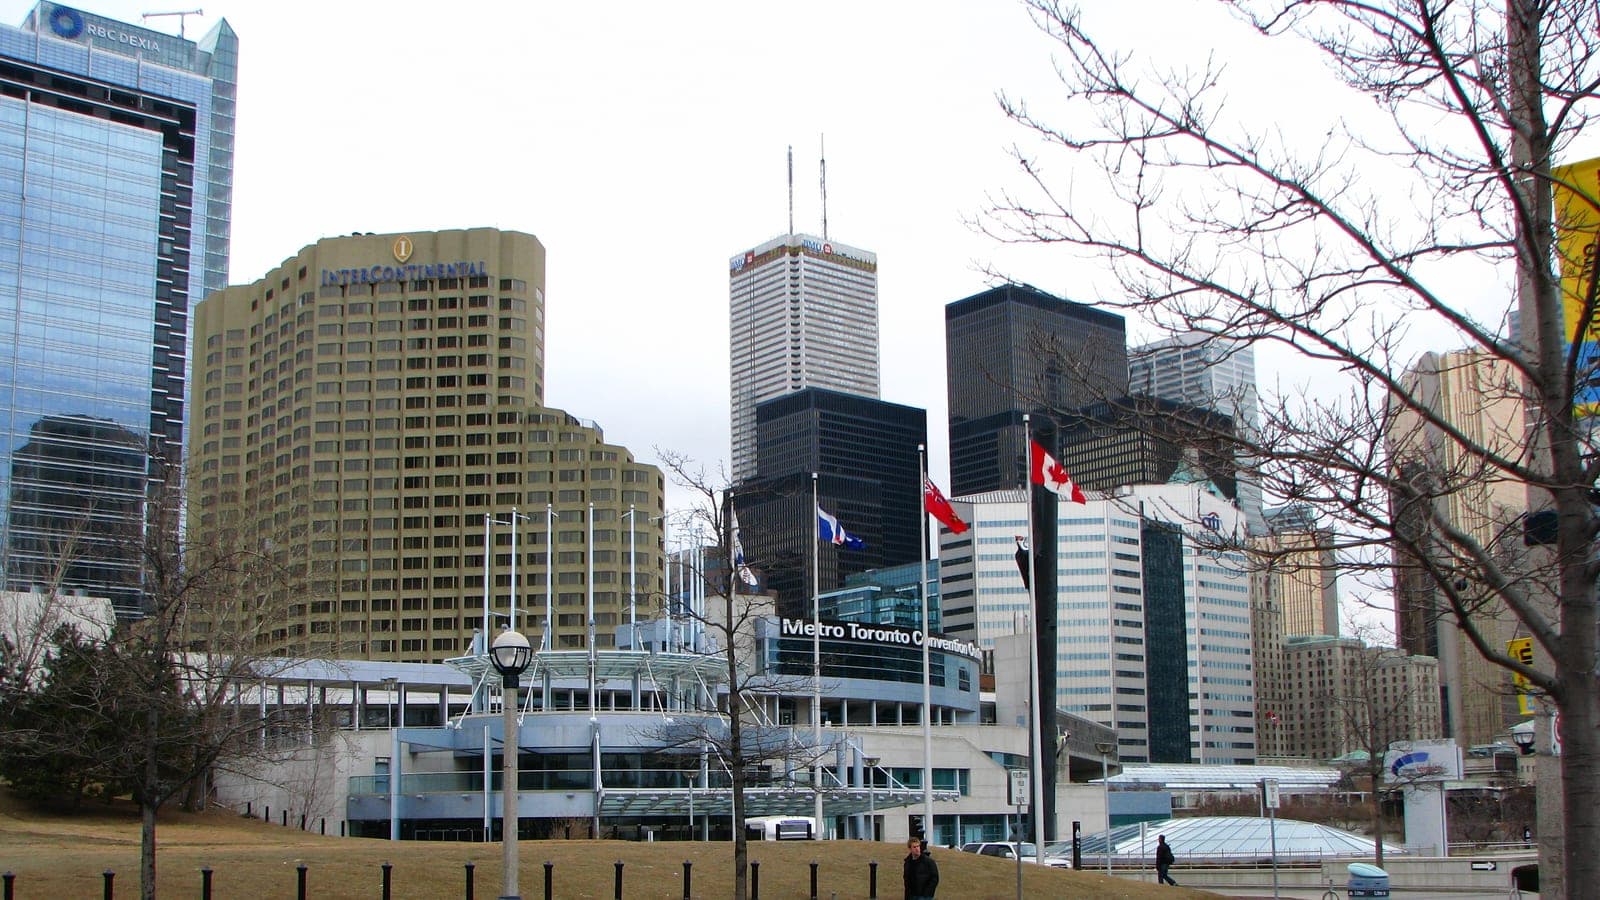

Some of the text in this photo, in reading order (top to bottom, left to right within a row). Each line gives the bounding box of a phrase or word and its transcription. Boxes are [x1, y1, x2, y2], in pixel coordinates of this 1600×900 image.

[88, 23, 160, 52] RBC DEXIA
[321, 261, 487, 286] INTERCONTINENTAL
[782, 618, 844, 638] Metro
[847, 623, 910, 644] Toronto
[912, 630, 968, 655] Cnvention
